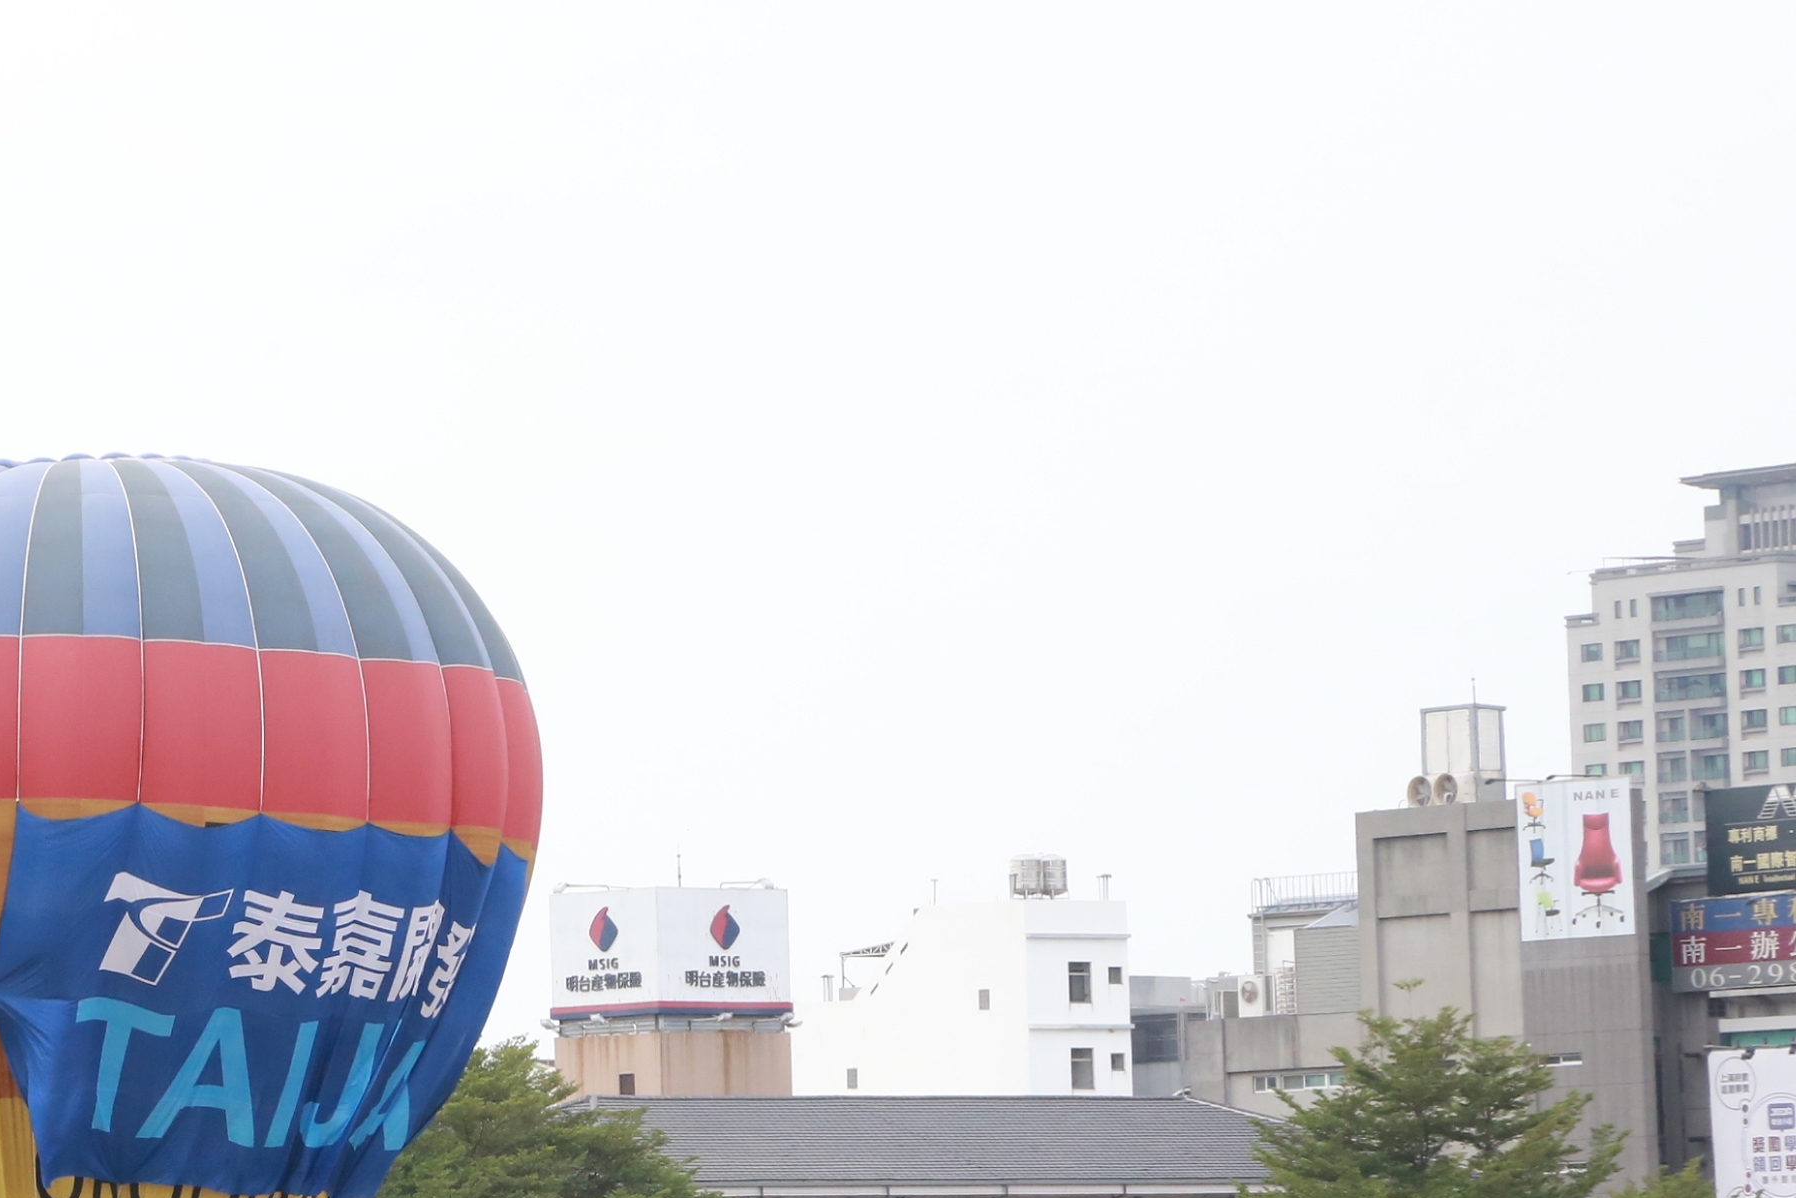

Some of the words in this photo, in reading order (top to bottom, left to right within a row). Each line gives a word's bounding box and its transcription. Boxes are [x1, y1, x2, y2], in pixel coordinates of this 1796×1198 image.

[1573, 789, 1605, 801] NAN
[1610, 788, 1620, 799] E
[588, 958, 619, 970] MSIG
[709, 955, 741, 968] MSIG
